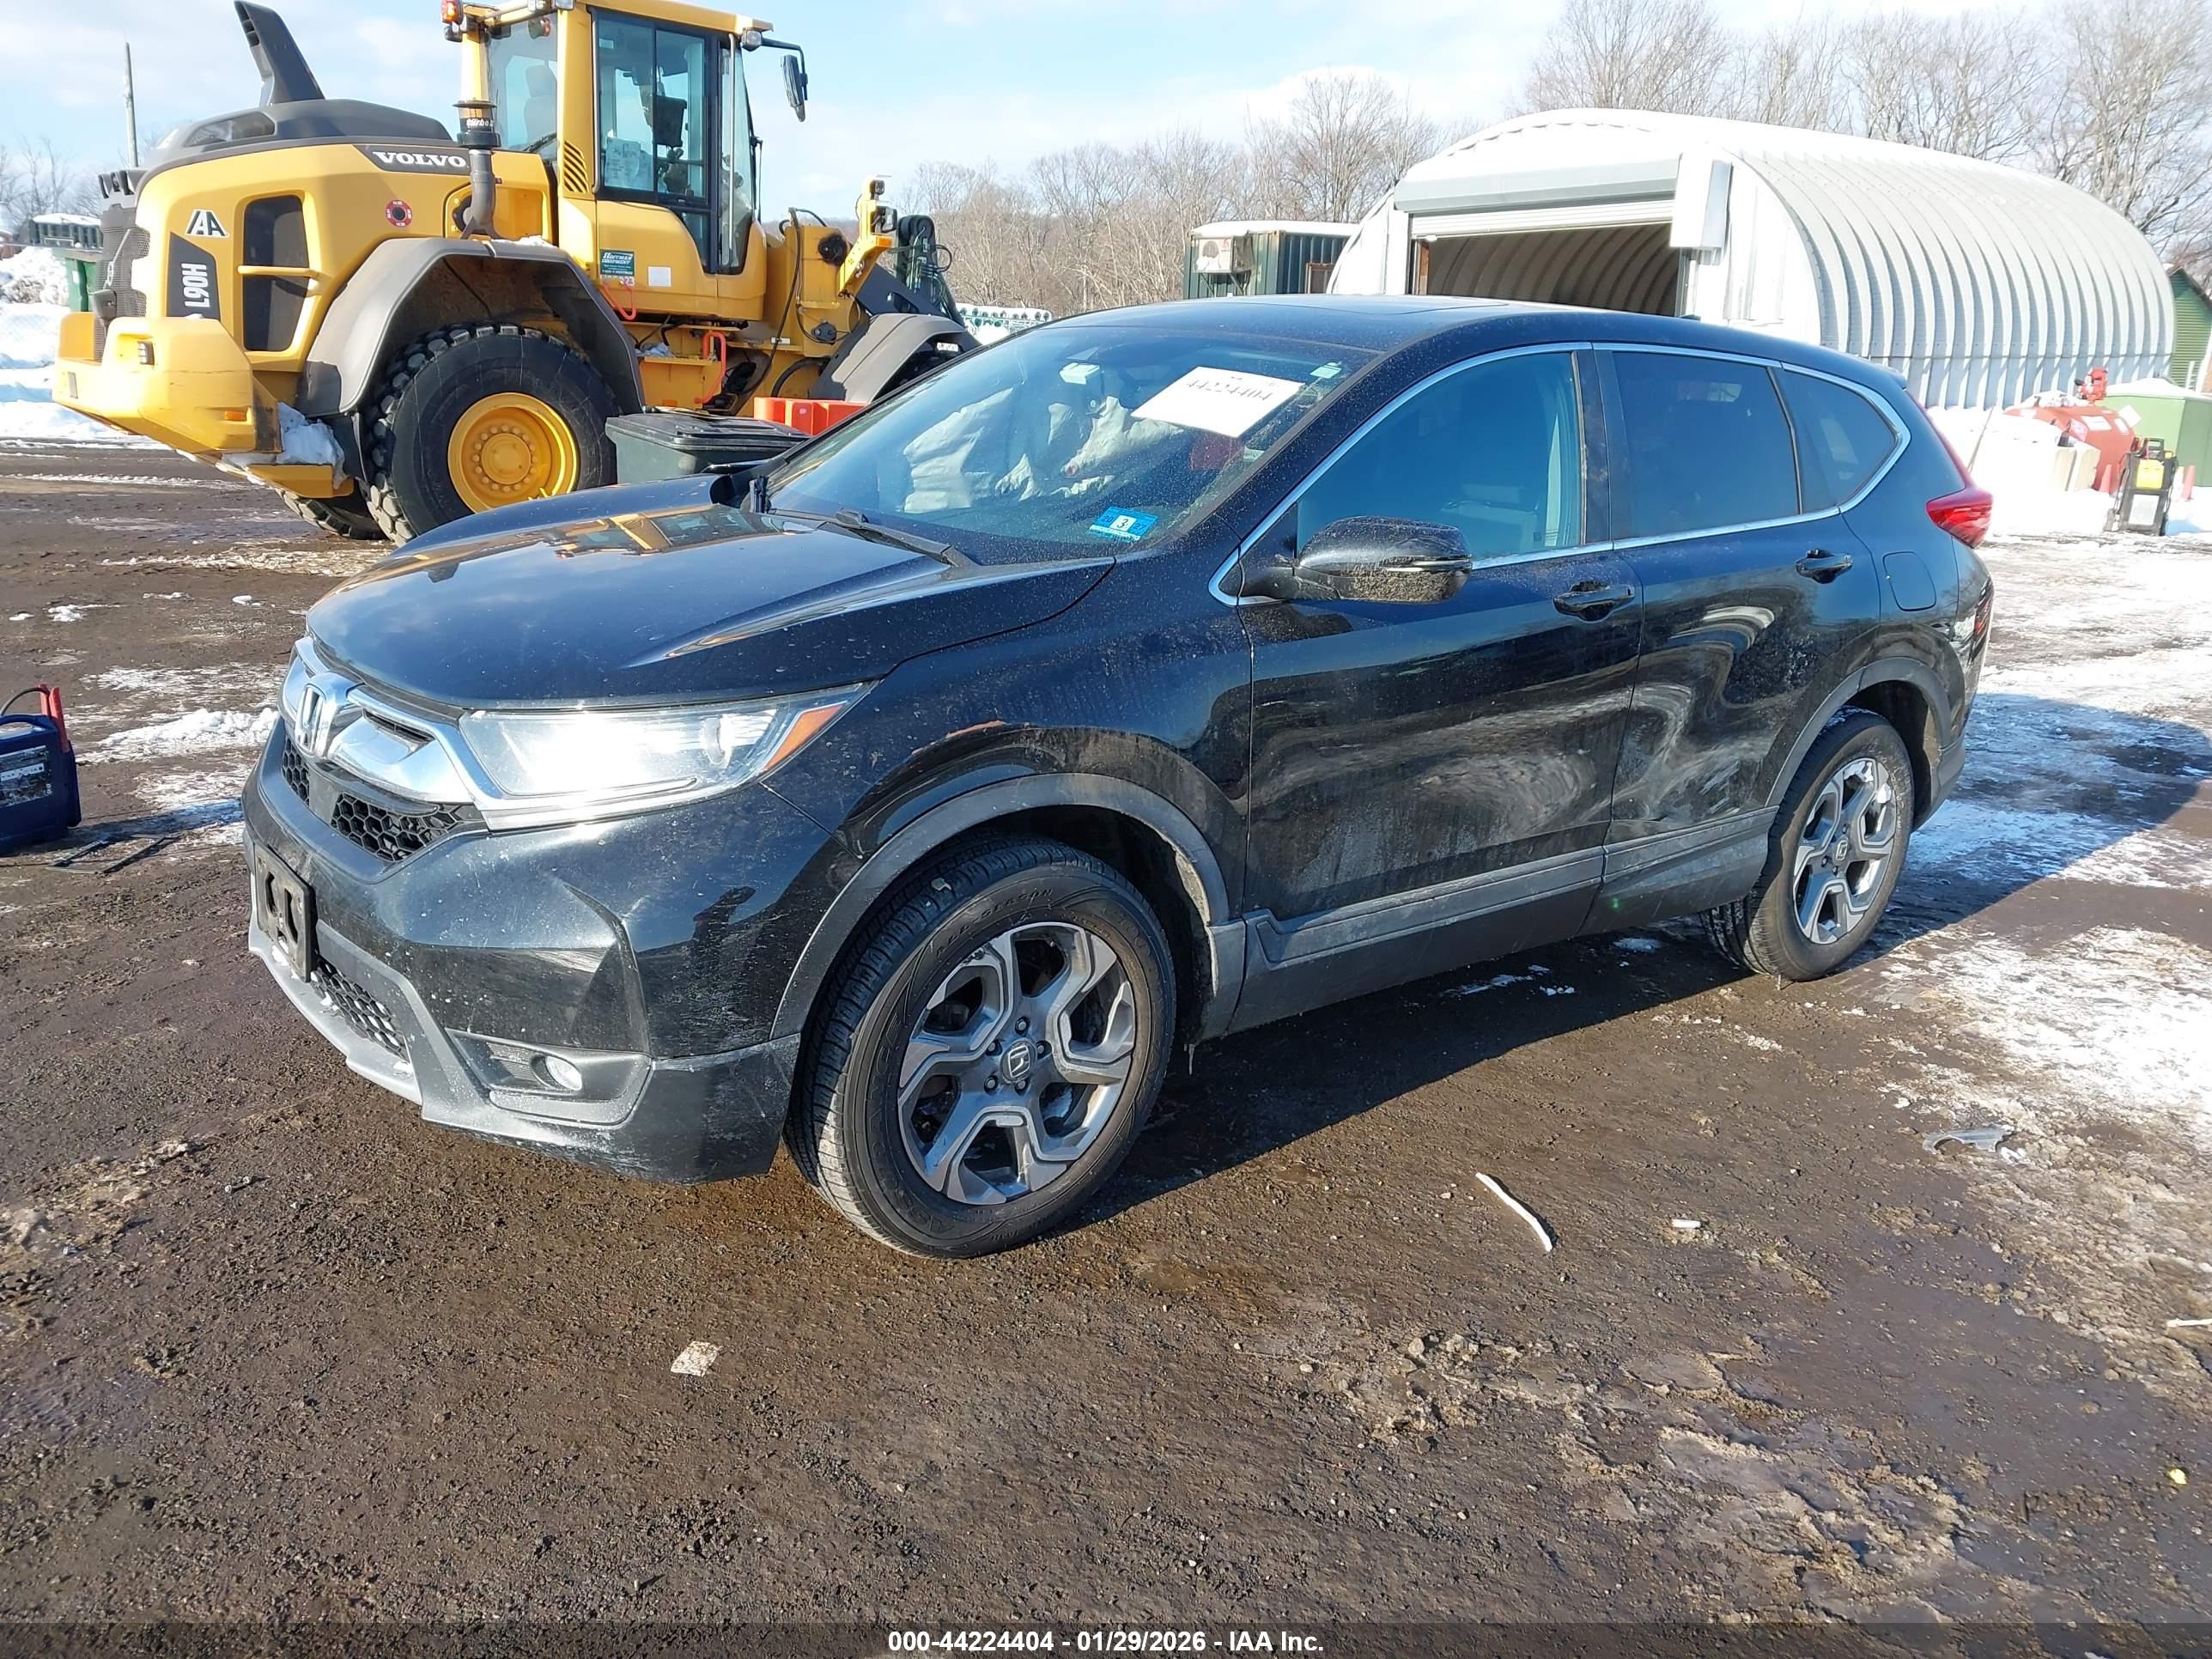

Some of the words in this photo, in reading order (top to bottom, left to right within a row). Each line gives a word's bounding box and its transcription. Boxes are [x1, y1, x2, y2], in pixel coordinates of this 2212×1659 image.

[372, 151, 466, 167] VOLVO
[181, 263, 210, 307] L90H
[1101, 515, 1115, 524] 20
[1116, 518, 1128, 529] 3
